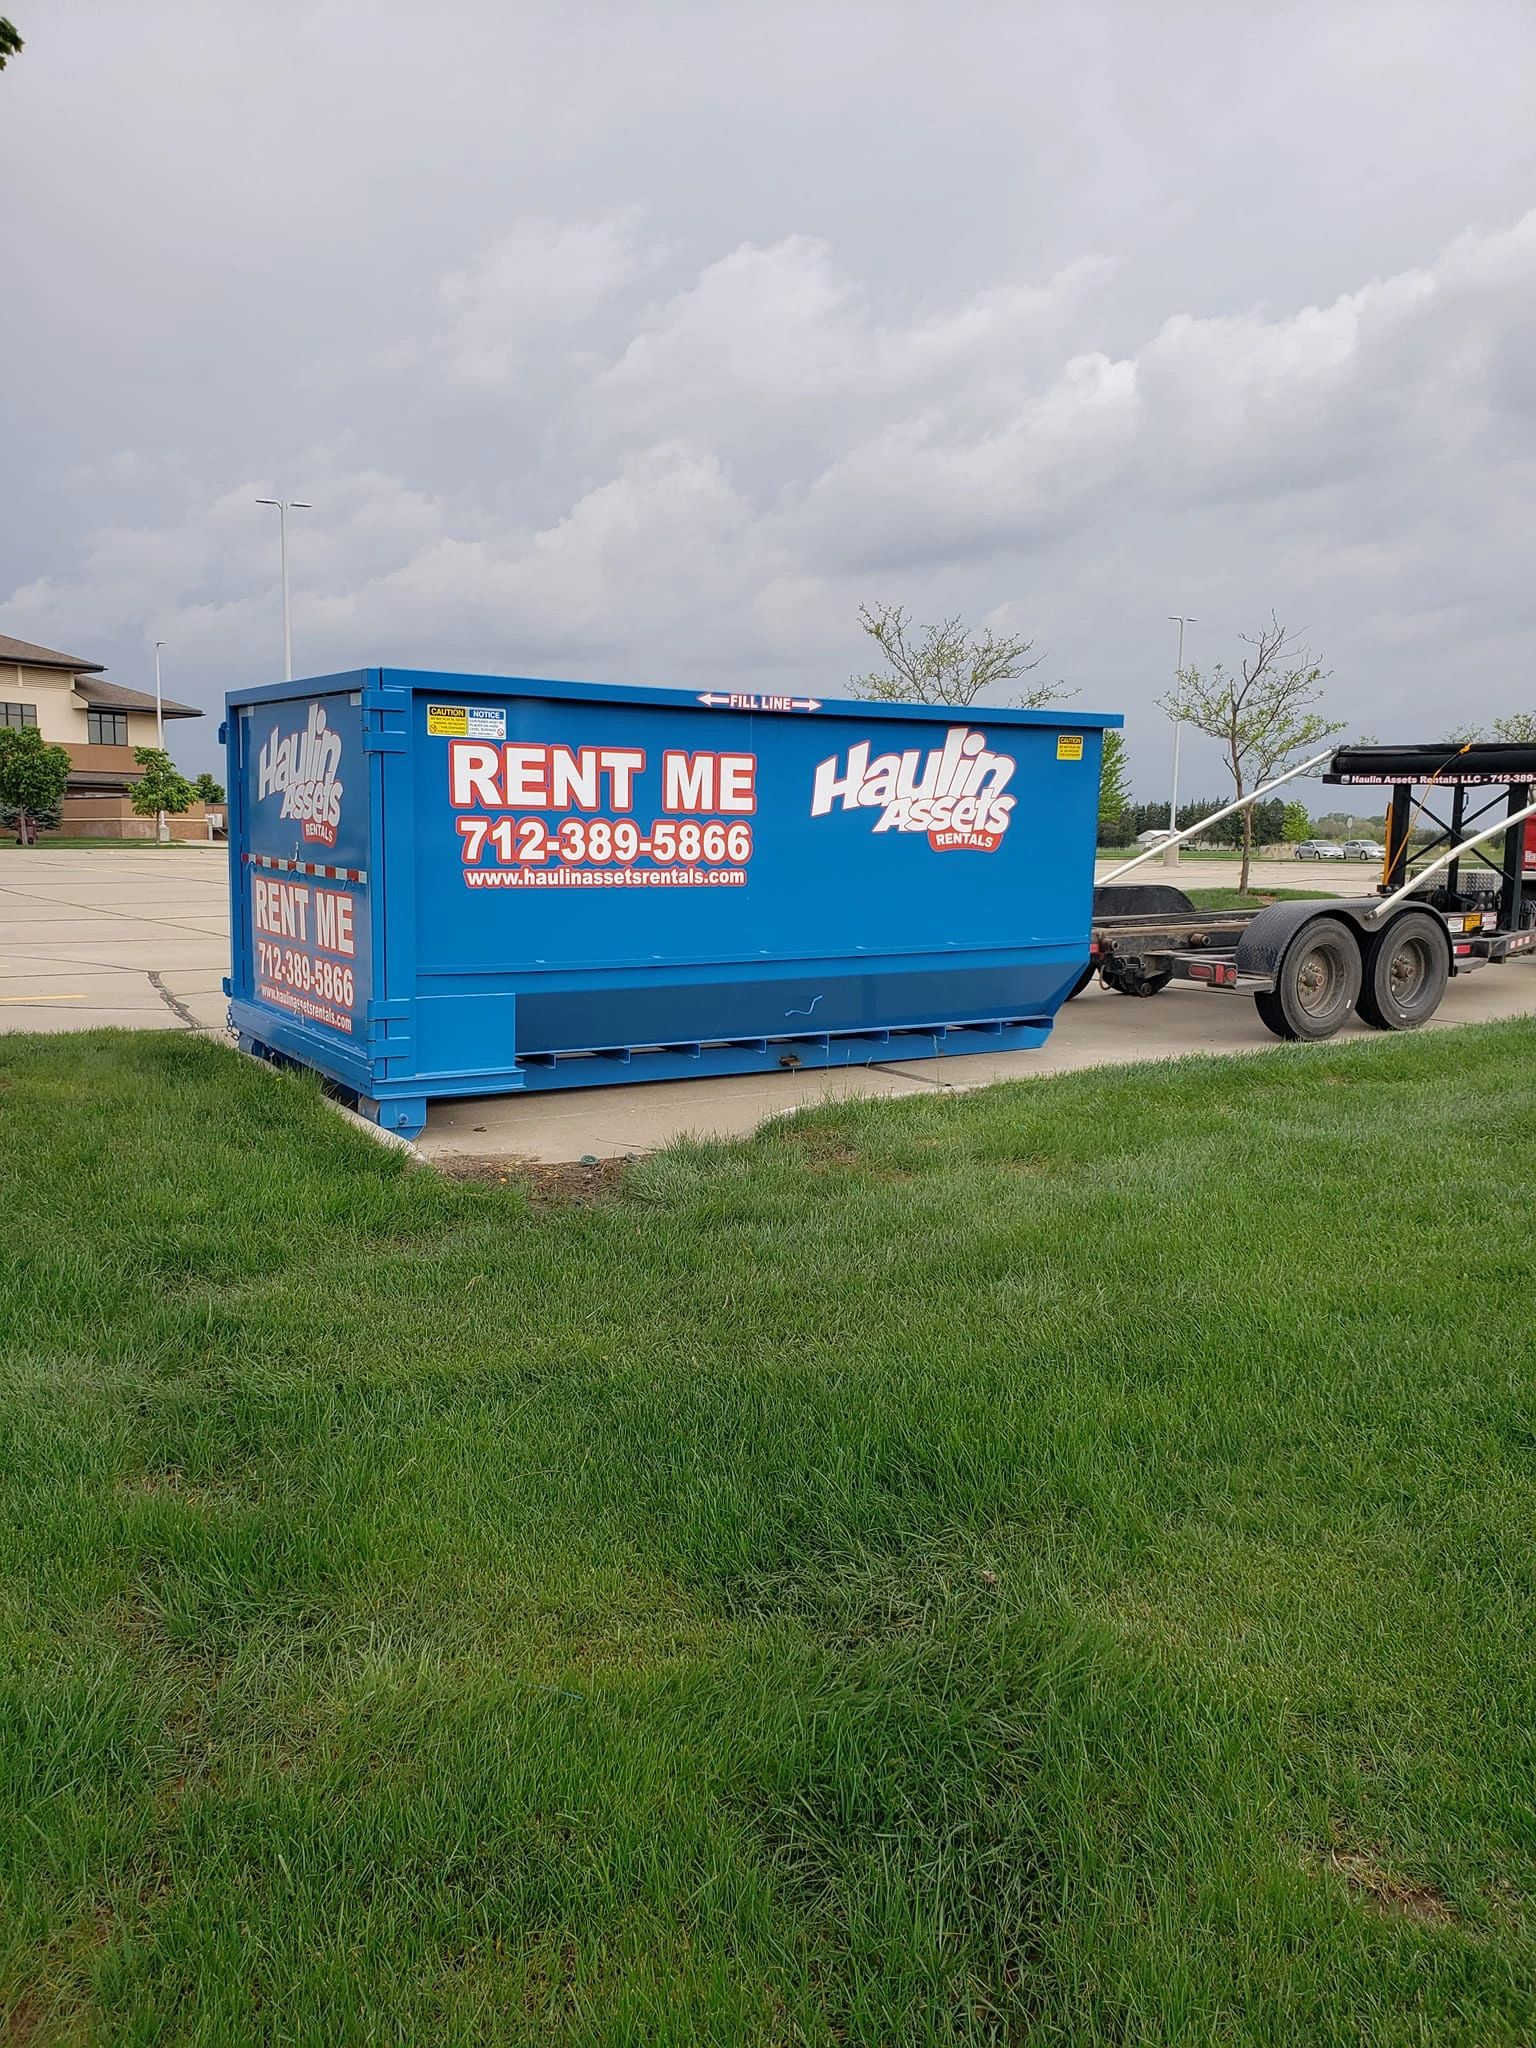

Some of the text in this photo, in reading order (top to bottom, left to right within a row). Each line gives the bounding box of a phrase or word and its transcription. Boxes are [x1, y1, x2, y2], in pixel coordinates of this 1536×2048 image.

[430, 707, 464, 717] CAUTION
[473, 710, 501, 719] NOTICE
[730, 694, 792, 710] FILL LINE
[258, 703, 342, 801] Haulin
[811, 727, 1016, 817] Haulin
[452, 743, 753, 811] RENT ME
[1351, 775, 1382, 784] Haulin
[1384, 776, 1417, 784] Assets
[1420, 776, 1458, 784] Rentals
[280, 773, 343, 827] Assets
[872, 788, 1016, 834] Assets
[305, 823, 334, 843] RENTALS
[460, 819, 750, 862] 712-389-5866
[935, 832, 994, 848] RENTALS
[466, 868, 745, 886] www.haulinassetsrentals.com
[255, 879, 354, 954] RENT ME
[258, 942, 354, 1007] 712-389-5866
